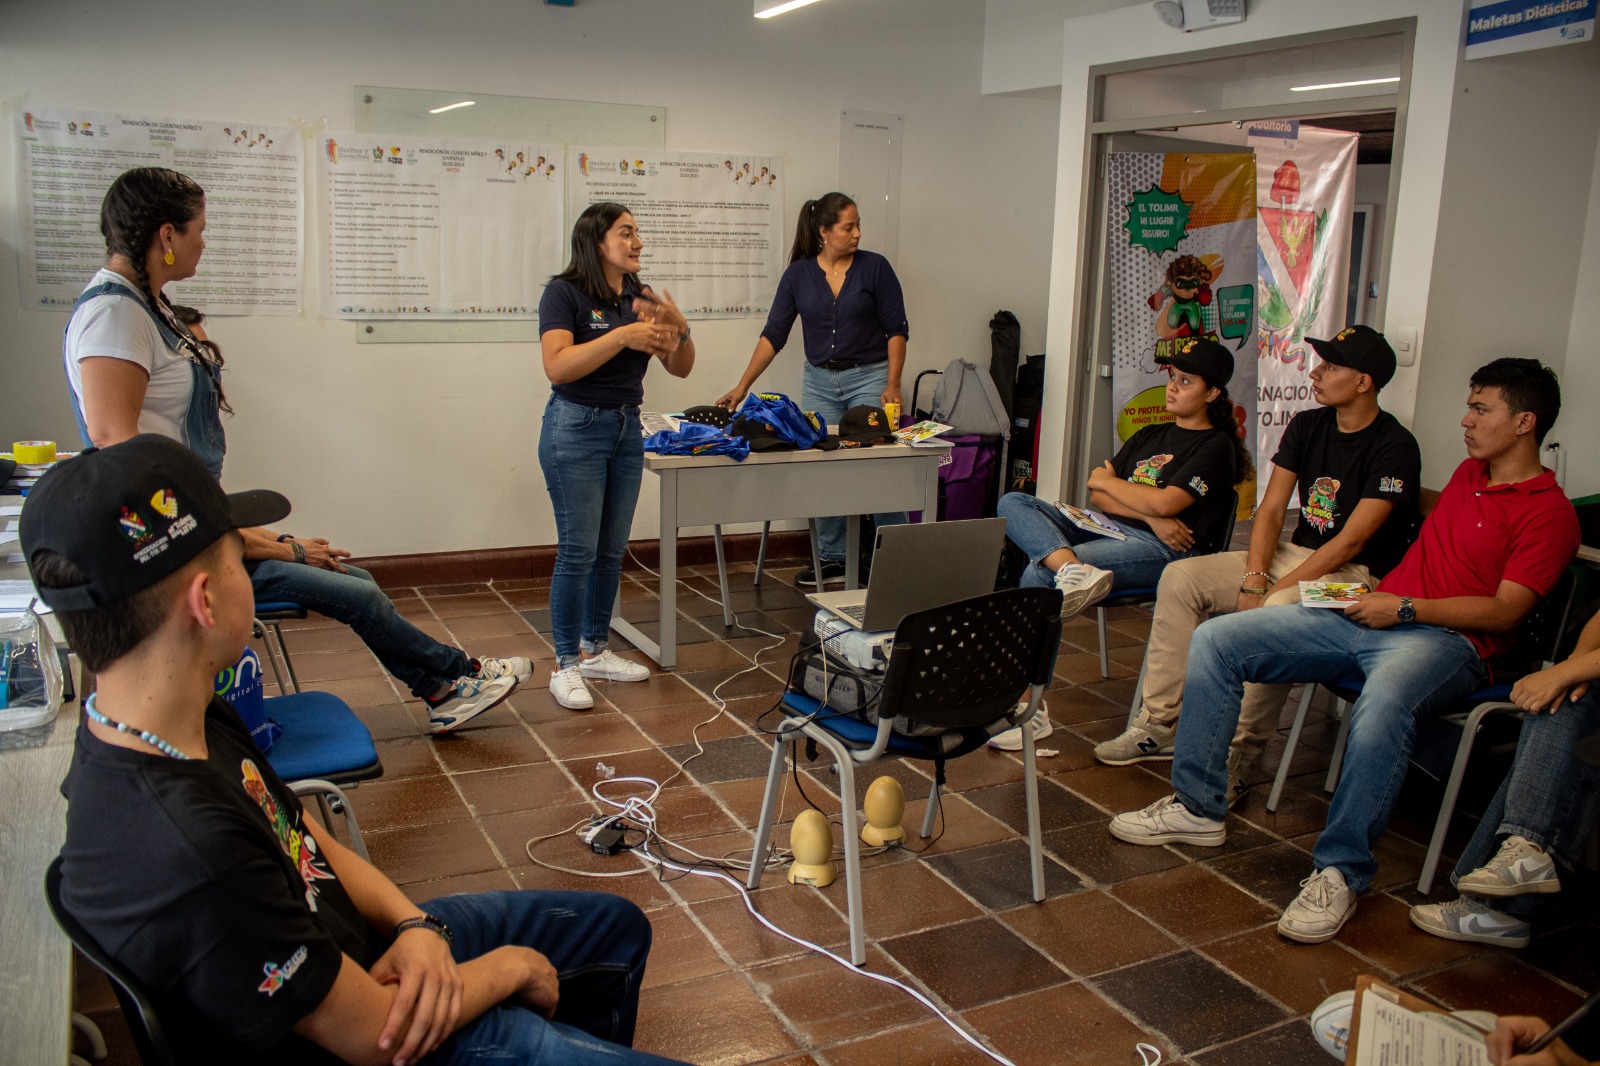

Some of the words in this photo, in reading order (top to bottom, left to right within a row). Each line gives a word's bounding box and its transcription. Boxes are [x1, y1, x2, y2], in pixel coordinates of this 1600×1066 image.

[1469, 12, 1522, 33] Maletas
[1524, 0, 1588, 19] Didácticas
[1138, 204, 1146, 212] EL
[1150, 217, 1174, 225] LUGAR
[1156, 340, 1172, 357] ME
[1132, 415, 1152, 424] NIÑOS
